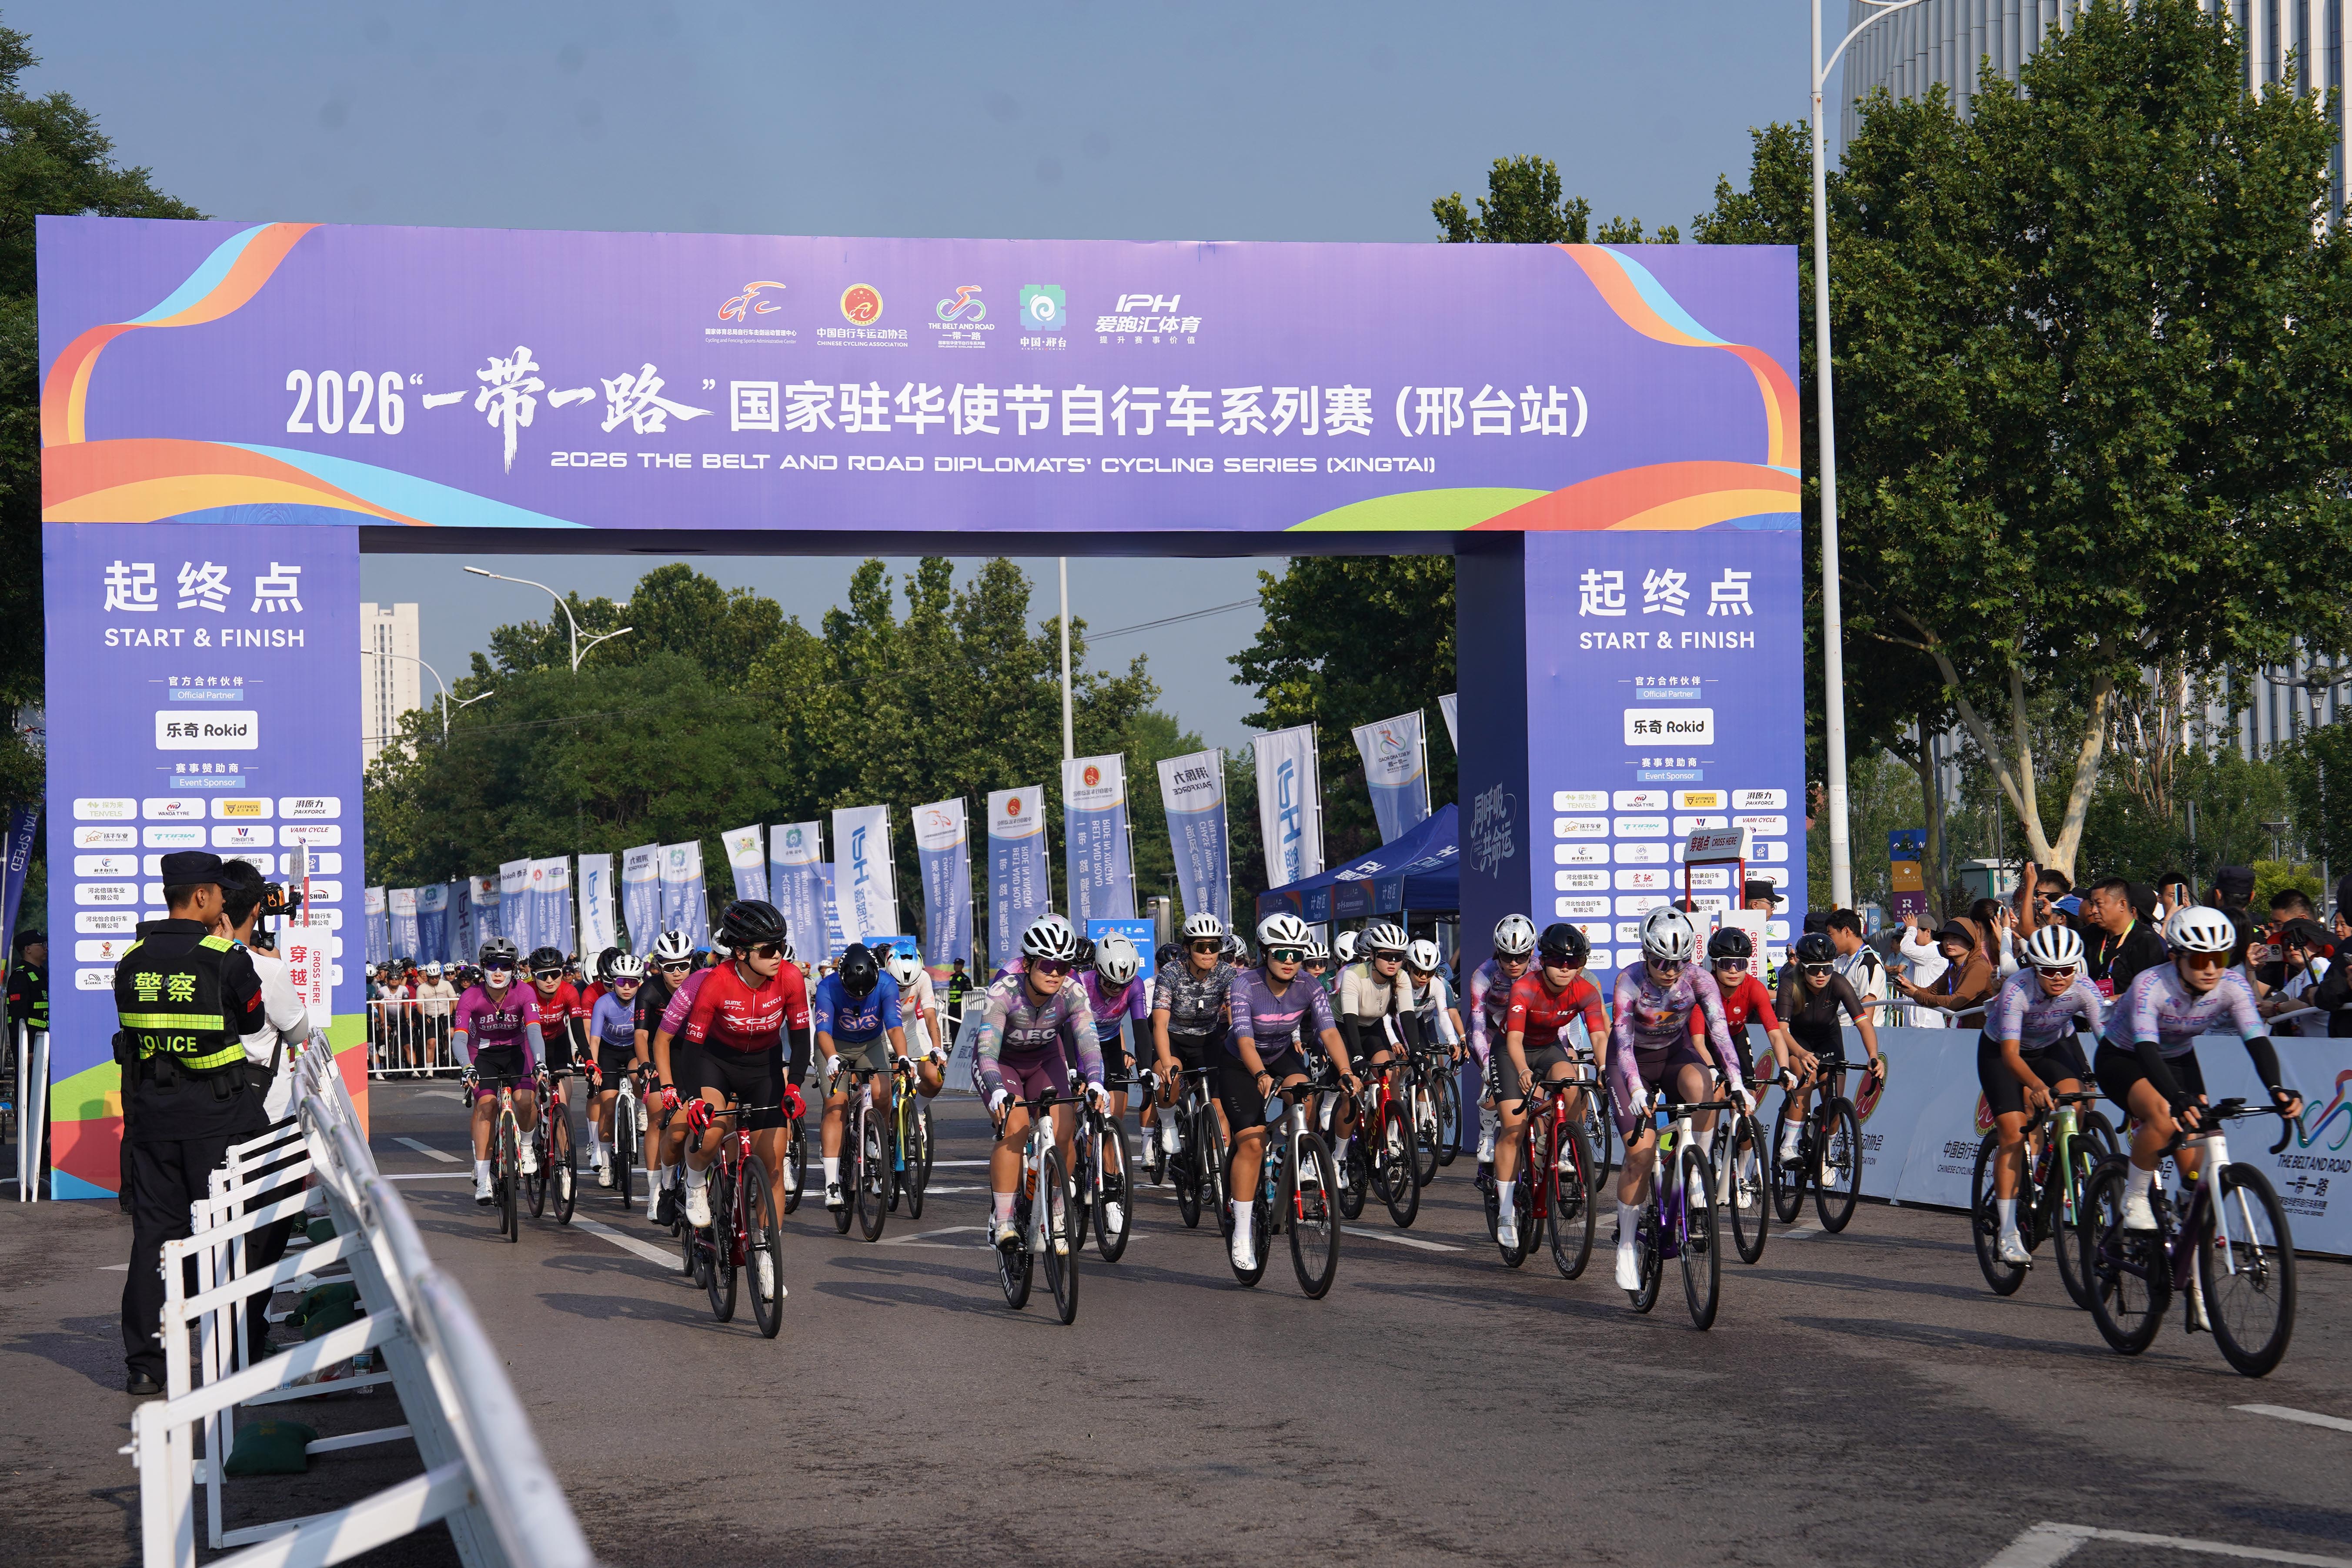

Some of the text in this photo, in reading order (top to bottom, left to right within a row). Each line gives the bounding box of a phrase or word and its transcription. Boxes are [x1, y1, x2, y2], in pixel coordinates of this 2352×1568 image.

[1115, 294, 1181, 313] IPH
[1095, 315, 1202, 334] 爱跑汇体育
[816, 328, 908, 340] 中国自行车运动协会
[942, 331, 981, 341] 一带一路
[1020, 336, 1067, 348] 中国·邢台
[1099, 335, 1196, 344] 提升赛事价值
[551, 451, 1436, 474] 2026 THE BELT AND ROAD DIPLOMATS' CYCLING SERIES (XINGTAI)
[104, 560, 304, 613] 起终点
[1578, 568, 1754, 617] 起终点
[104, 628, 304, 647] START & FINISH
[1579, 631, 1755, 649] START & FINISH
[168, 676, 244, 686] 官方合作伙伴
[1635, 675, 1701, 686] 官方合作伙伴
[177, 691, 235, 699] Official Partner
[166, 722, 247, 738] 乐奇 Rokid
[1634, 719, 1704, 734] 乐奇 Rokid
[175, 763, 239, 773] 赛事赞助商
[1641, 757, 1697, 768] 赛事赞助商
[204, 779, 236, 788] Sponsor
[1666, 772, 1695, 781] Sponsor
[295, 799, 324, 808] 湃原力
[1470, 779, 1507, 839] 同呼吸
[1480, 818, 1515, 879] 共命运
[1689, 835, 1737, 852] 穿越点 CROSS HERE
[1382, 883, 1397, 900] 计时区
[1310, 894, 1326, 910] 计时区
[134, 972, 197, 1003] 警察
[762, 996, 782, 1009] MCYCLE
[479, 1013, 519, 1024] BRKE
[138, 1035, 198, 1053] POLICE
[1937, 1164, 1974, 1175] CHINESE CYCLING
[2277, 1154, 2352, 1173] THE BELT AND ROAD
[2285, 1175, 2330, 1197] 一带一路
